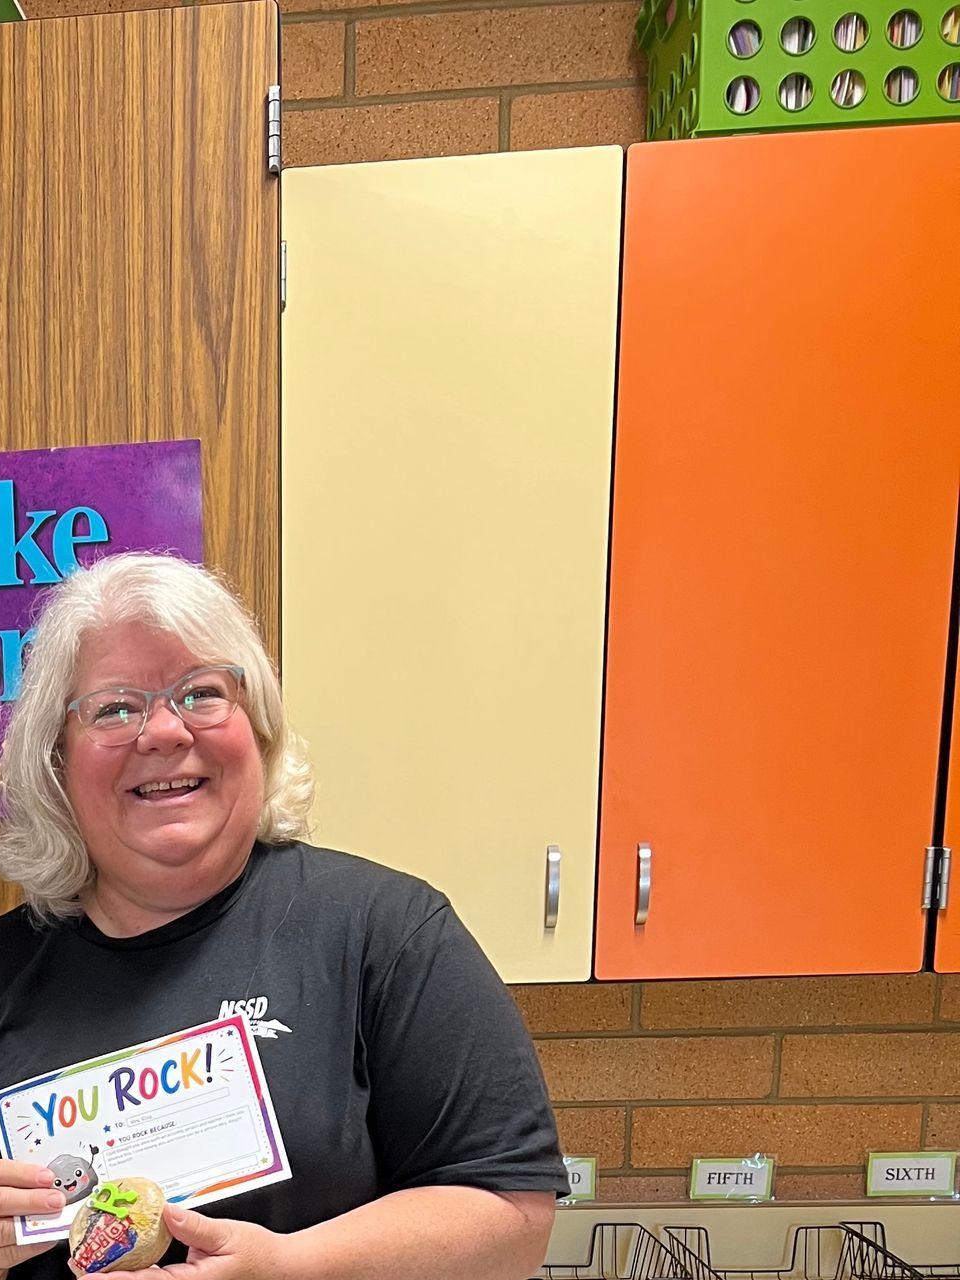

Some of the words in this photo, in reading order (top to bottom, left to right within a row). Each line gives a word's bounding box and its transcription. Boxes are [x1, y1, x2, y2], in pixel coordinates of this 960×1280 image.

[32, 1085, 99, 1137] YOU
[108, 1043, 213, 1112] ROCK!
[118, 1135, 131, 1143] YOU
[132, 1129, 149, 1139] ROCK
[706, 1172, 754, 1185] FIFTH
[885, 1167, 936, 1181] SIXTH
